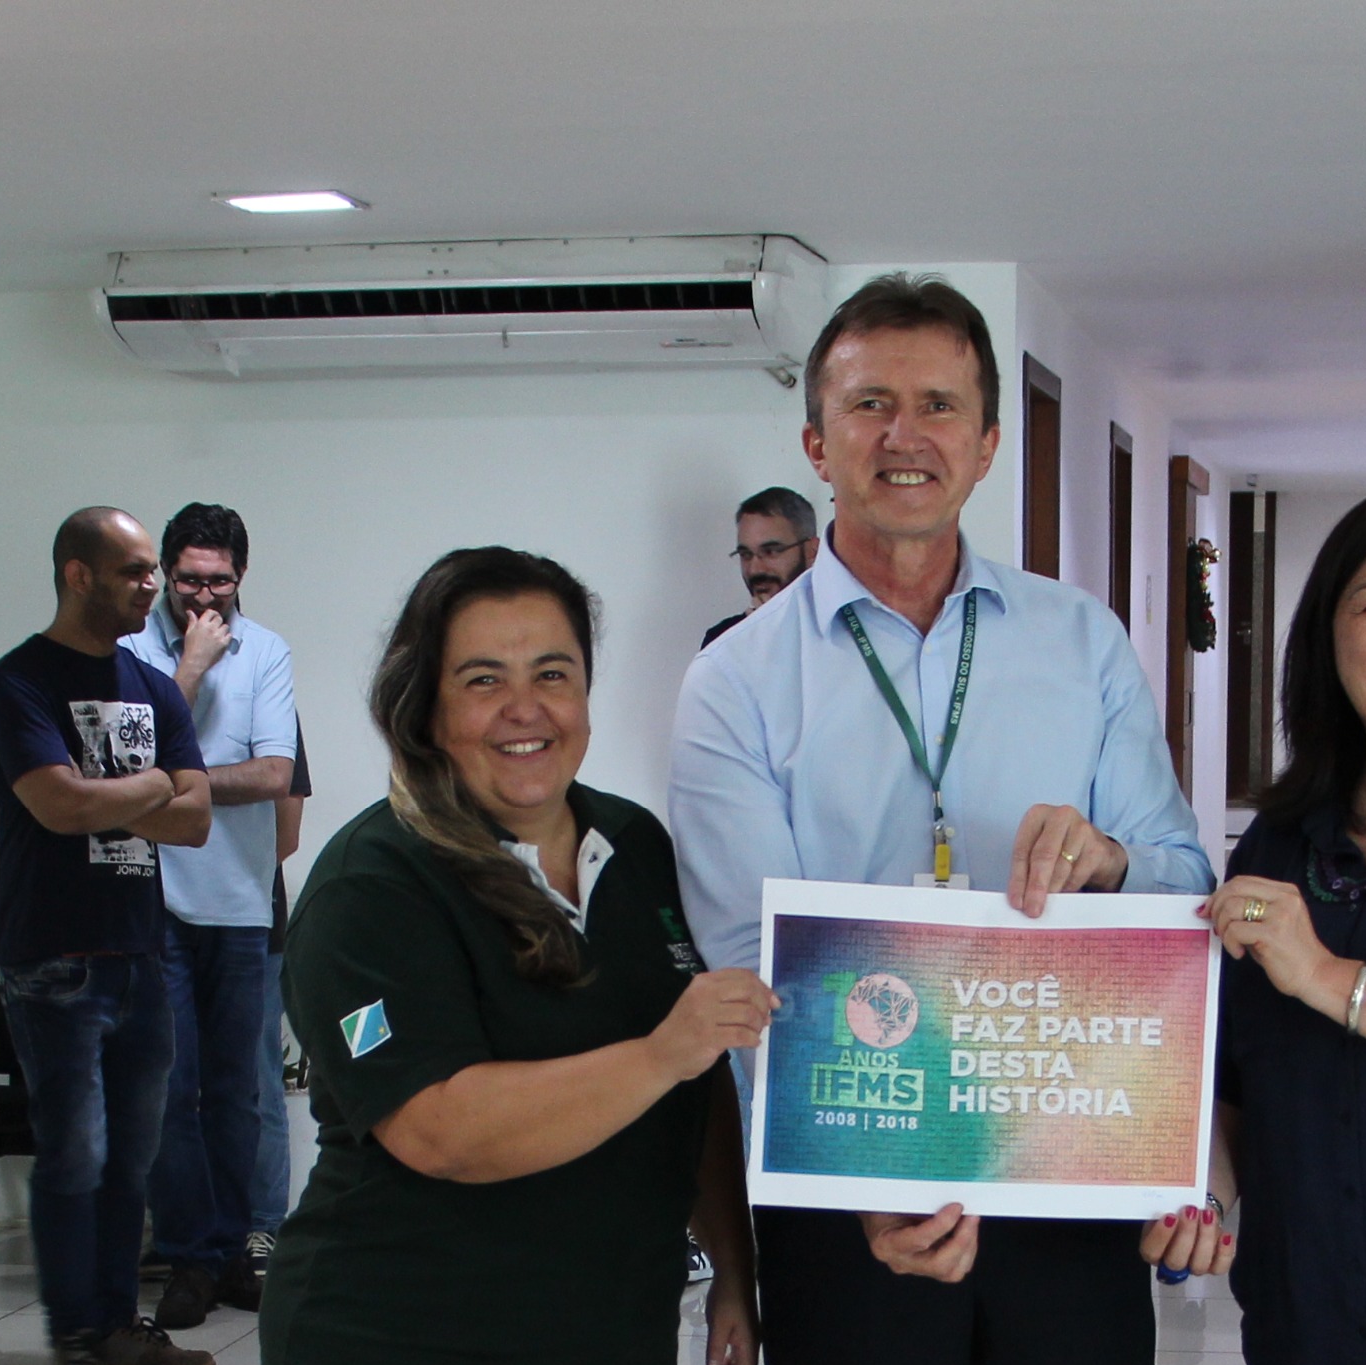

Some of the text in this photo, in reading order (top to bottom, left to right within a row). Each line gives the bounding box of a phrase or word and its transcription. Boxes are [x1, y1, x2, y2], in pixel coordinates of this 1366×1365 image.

[847, 616, 859, 632] SUL
[858, 636, 873, 657] IFMS
[962, 624, 974, 660] GROSSO
[960, 661, 970, 676] DO
[955, 676, 967, 695] SUL
[950, 702, 962, 724] IFMS
[116, 865, 141, 876] JOHN
[951, 974, 1060, 1008] VOCÊ
[951, 1014, 1163, 1046] FAZ PARTE
[839, 1049, 899, 1068] ANOS
[950, 1049, 1076, 1079] DESTA
[817, 1068, 918, 1105] IFMS
[949, 1079, 1132, 1117] HISTÓRIA
[814, 1110, 856, 1126] 2008
[876, 1114, 918, 1130] 2018
